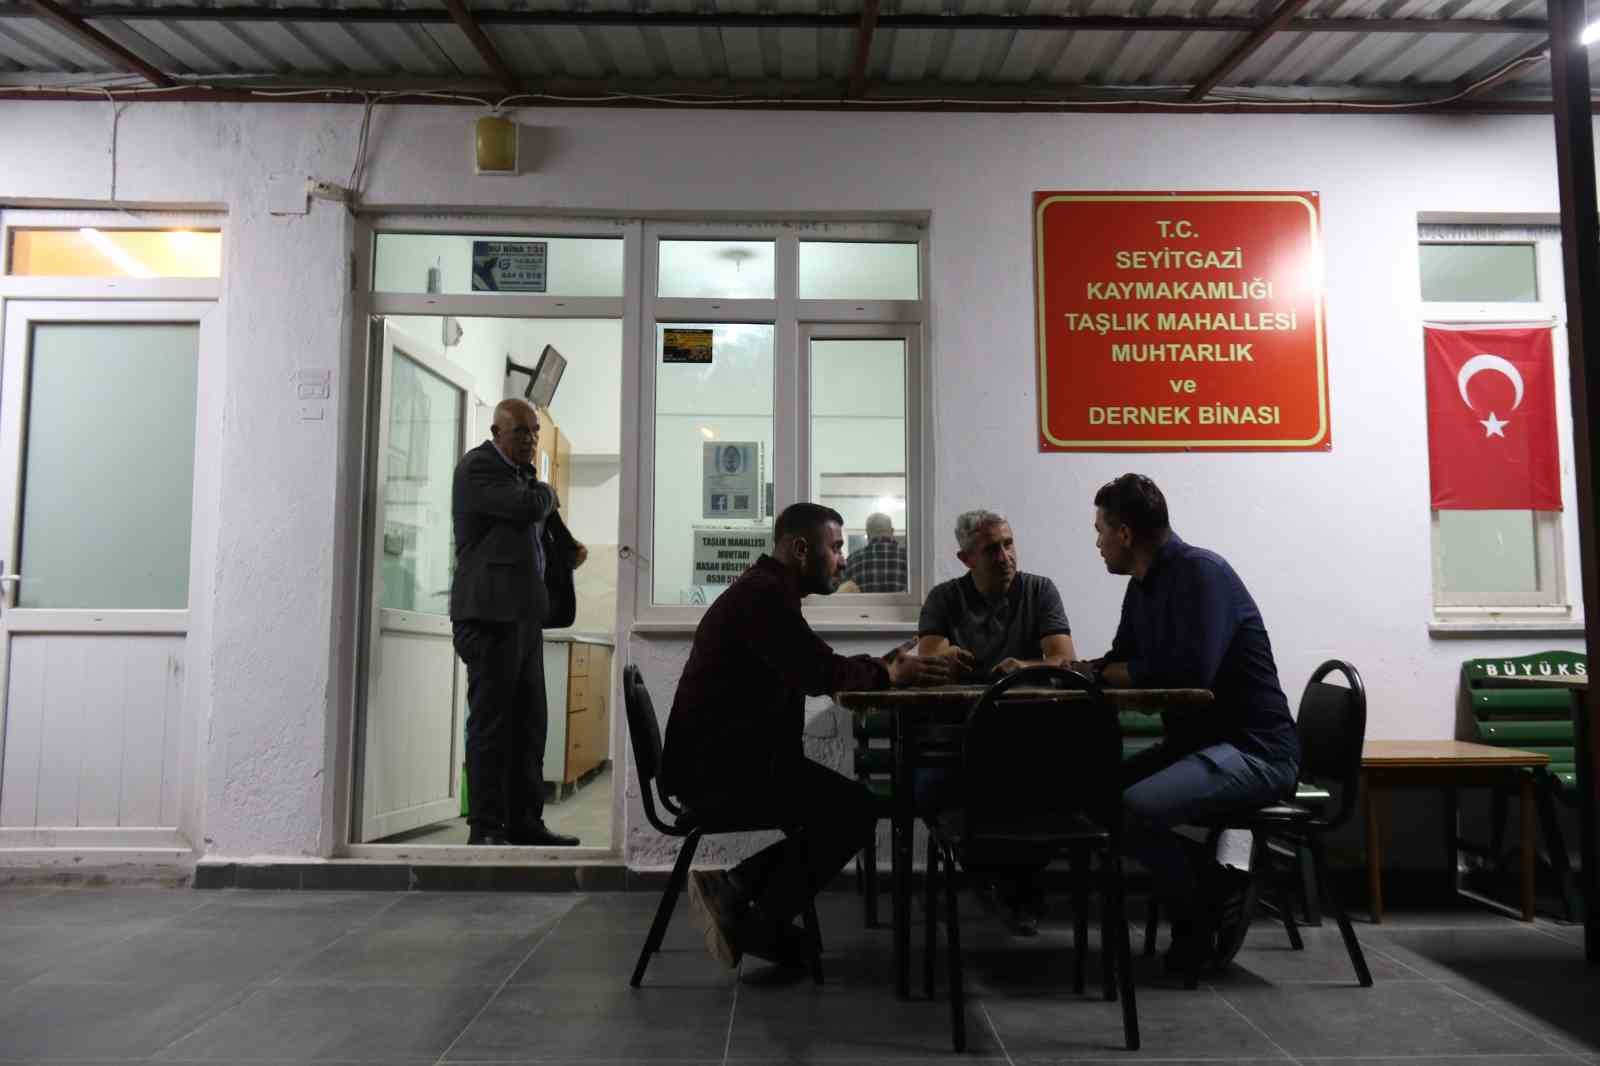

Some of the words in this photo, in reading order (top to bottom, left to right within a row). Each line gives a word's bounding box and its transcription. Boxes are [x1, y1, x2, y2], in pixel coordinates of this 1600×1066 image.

[1157, 220, 1199, 239] T.C.
[1115, 247, 1243, 269] SEYİTGAZİ
[1087, 277, 1273, 300] KAYMAKAMLIĞI
[1064, 313, 1149, 335] TAŞLIK
[1157, 310, 1297, 331] MAHALLESİ
[1111, 343, 1254, 362] MUHTARLIK
[1169, 378, 1197, 393] ve
[1088, 406, 1191, 425] DERNEK
[1198, 402, 1280, 425] BİNASI
